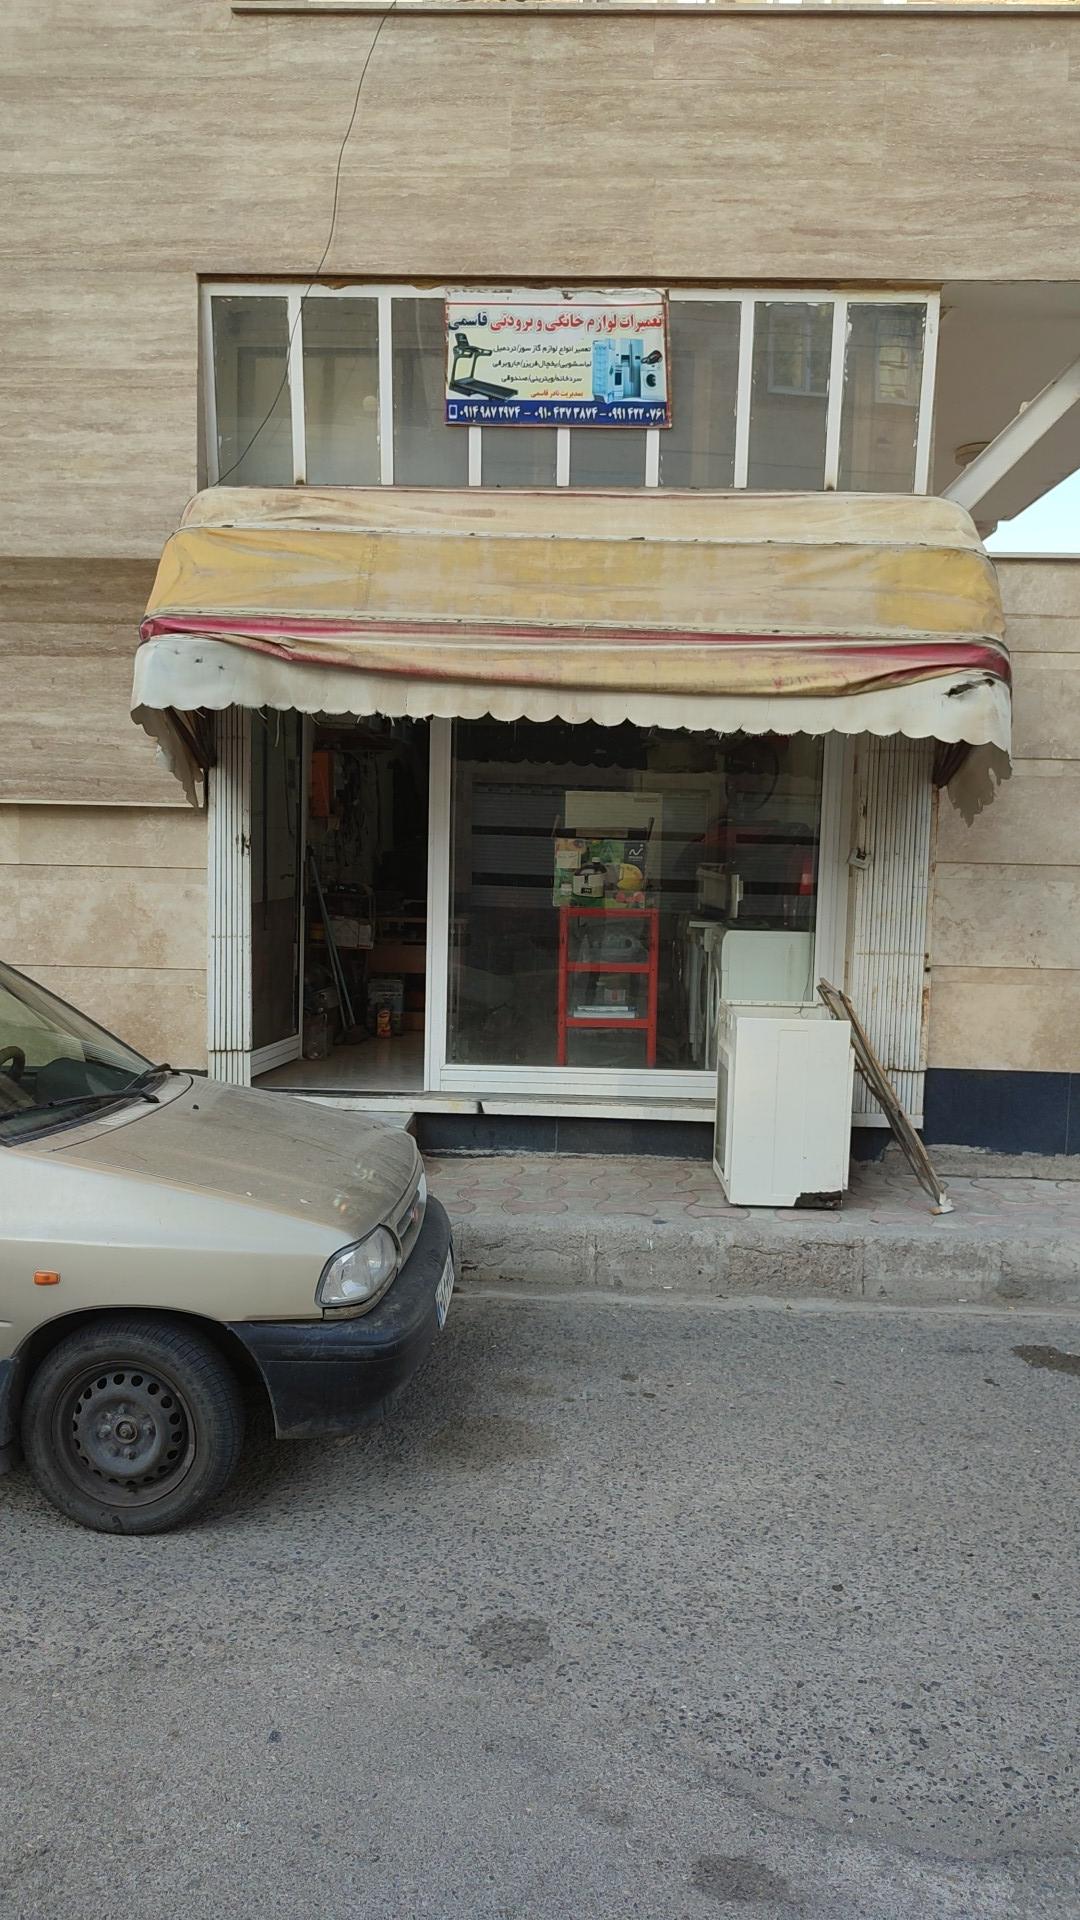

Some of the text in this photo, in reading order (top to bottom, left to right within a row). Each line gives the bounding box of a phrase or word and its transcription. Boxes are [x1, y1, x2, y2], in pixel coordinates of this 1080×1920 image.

[448, 311, 664, 333] تعمیرات لوازم خانگی و برودتی قاسمی
[542, 344, 558, 353] لوازم
[559, 345, 574, 355] انواع
[575, 345, 592, 354] تعمیر
[530, 389, 549, 398] قاسمی
